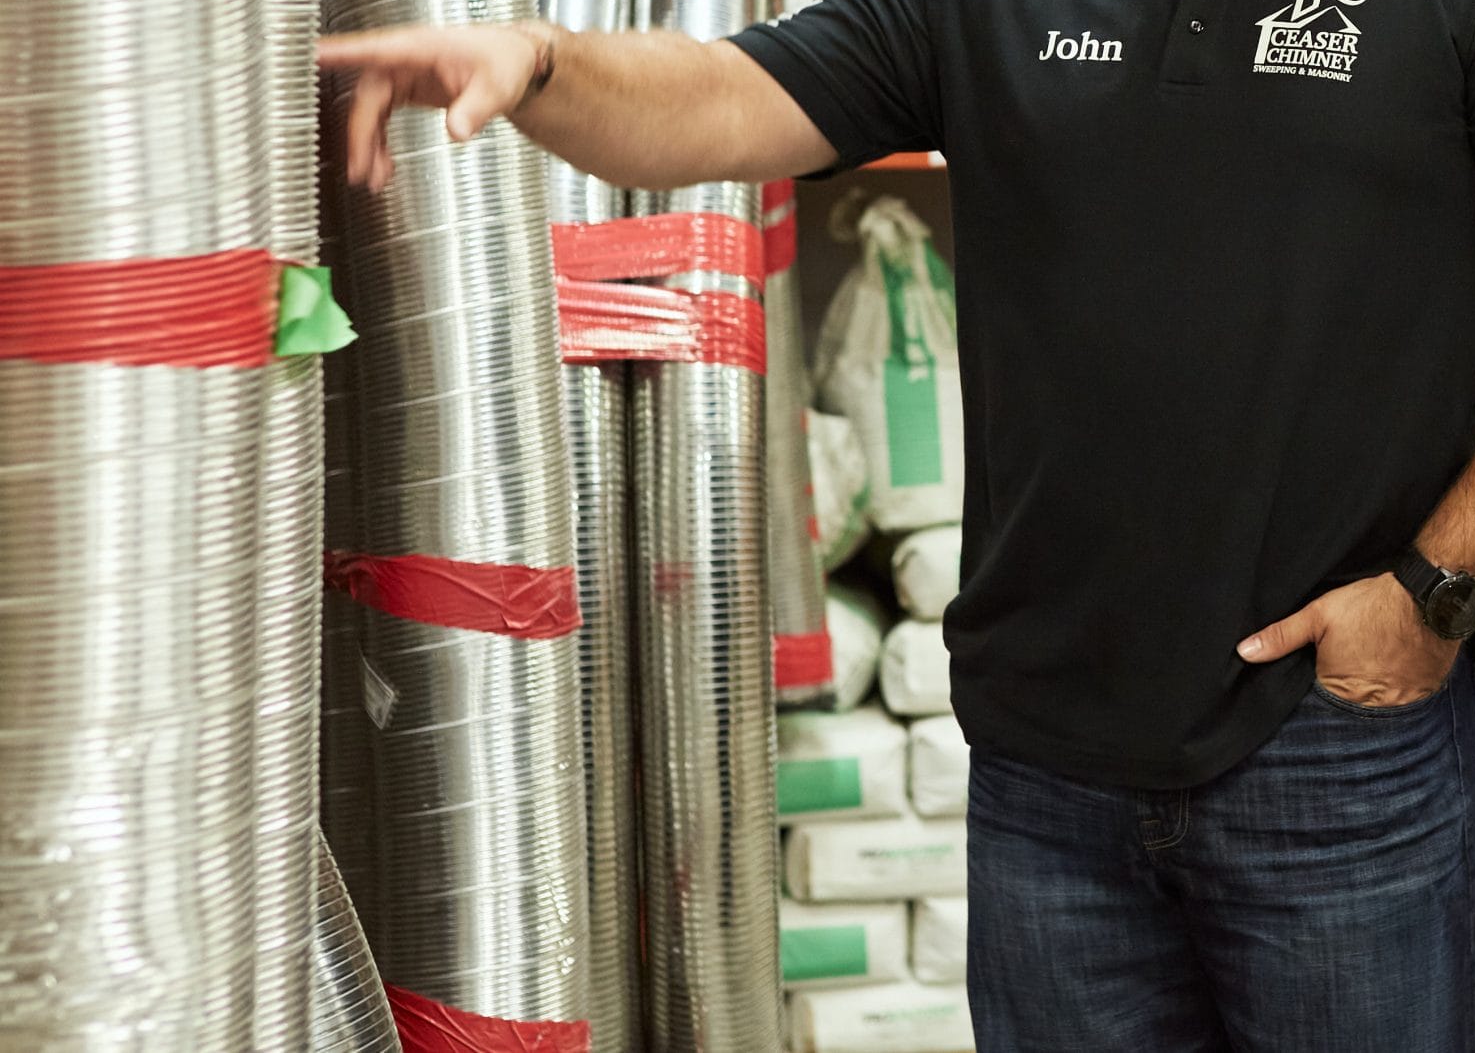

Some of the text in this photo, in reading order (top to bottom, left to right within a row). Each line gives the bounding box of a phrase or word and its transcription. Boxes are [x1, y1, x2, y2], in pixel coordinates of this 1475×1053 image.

[1039, 30, 1123, 61] John
[1271, 29, 1358, 54] CEASER
[1266, 47, 1358, 71] CHIMNEY
[1253, 64, 1352, 83] SWEEPING & MASONRY
